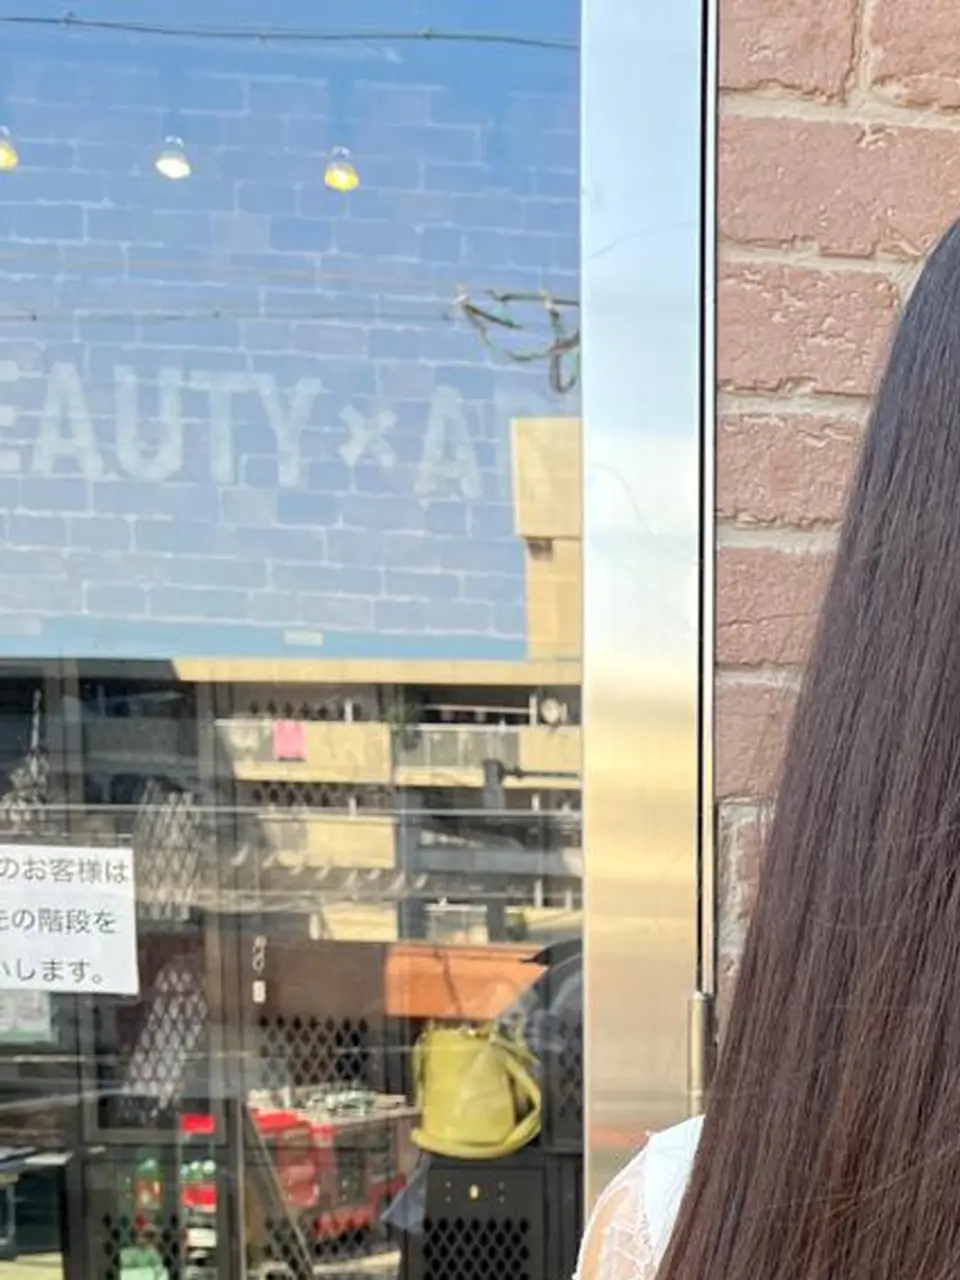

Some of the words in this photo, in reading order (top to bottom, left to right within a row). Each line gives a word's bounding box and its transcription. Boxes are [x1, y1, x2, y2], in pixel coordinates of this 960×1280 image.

[0, 857, 129, 883] のお客様は
